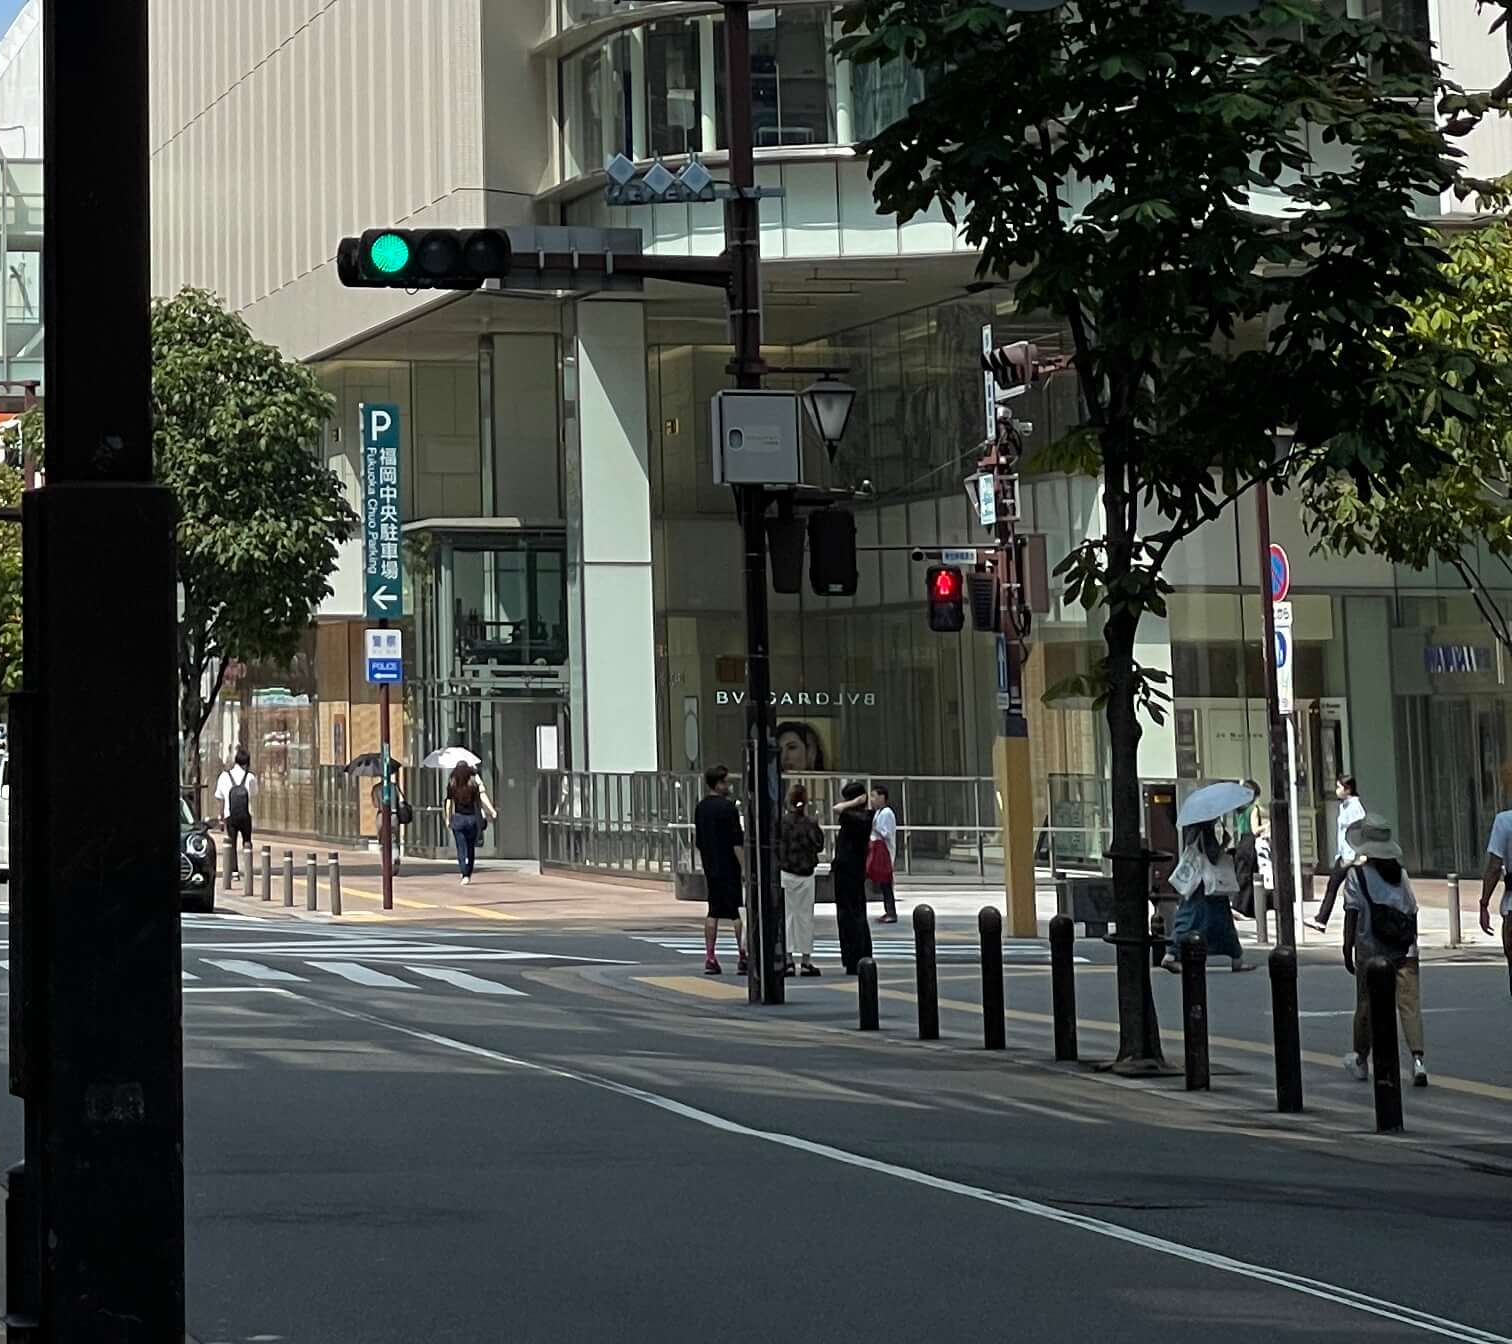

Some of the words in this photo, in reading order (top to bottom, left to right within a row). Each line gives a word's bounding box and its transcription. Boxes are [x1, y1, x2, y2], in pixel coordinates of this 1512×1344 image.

[371, 410, 391, 441] P
[366, 447, 378, 496] Fukuoka
[367, 499, 378, 529] Chuo
[379, 447, 399, 581] 福岡中央駐車場
[367, 532, 379, 576] Parking
